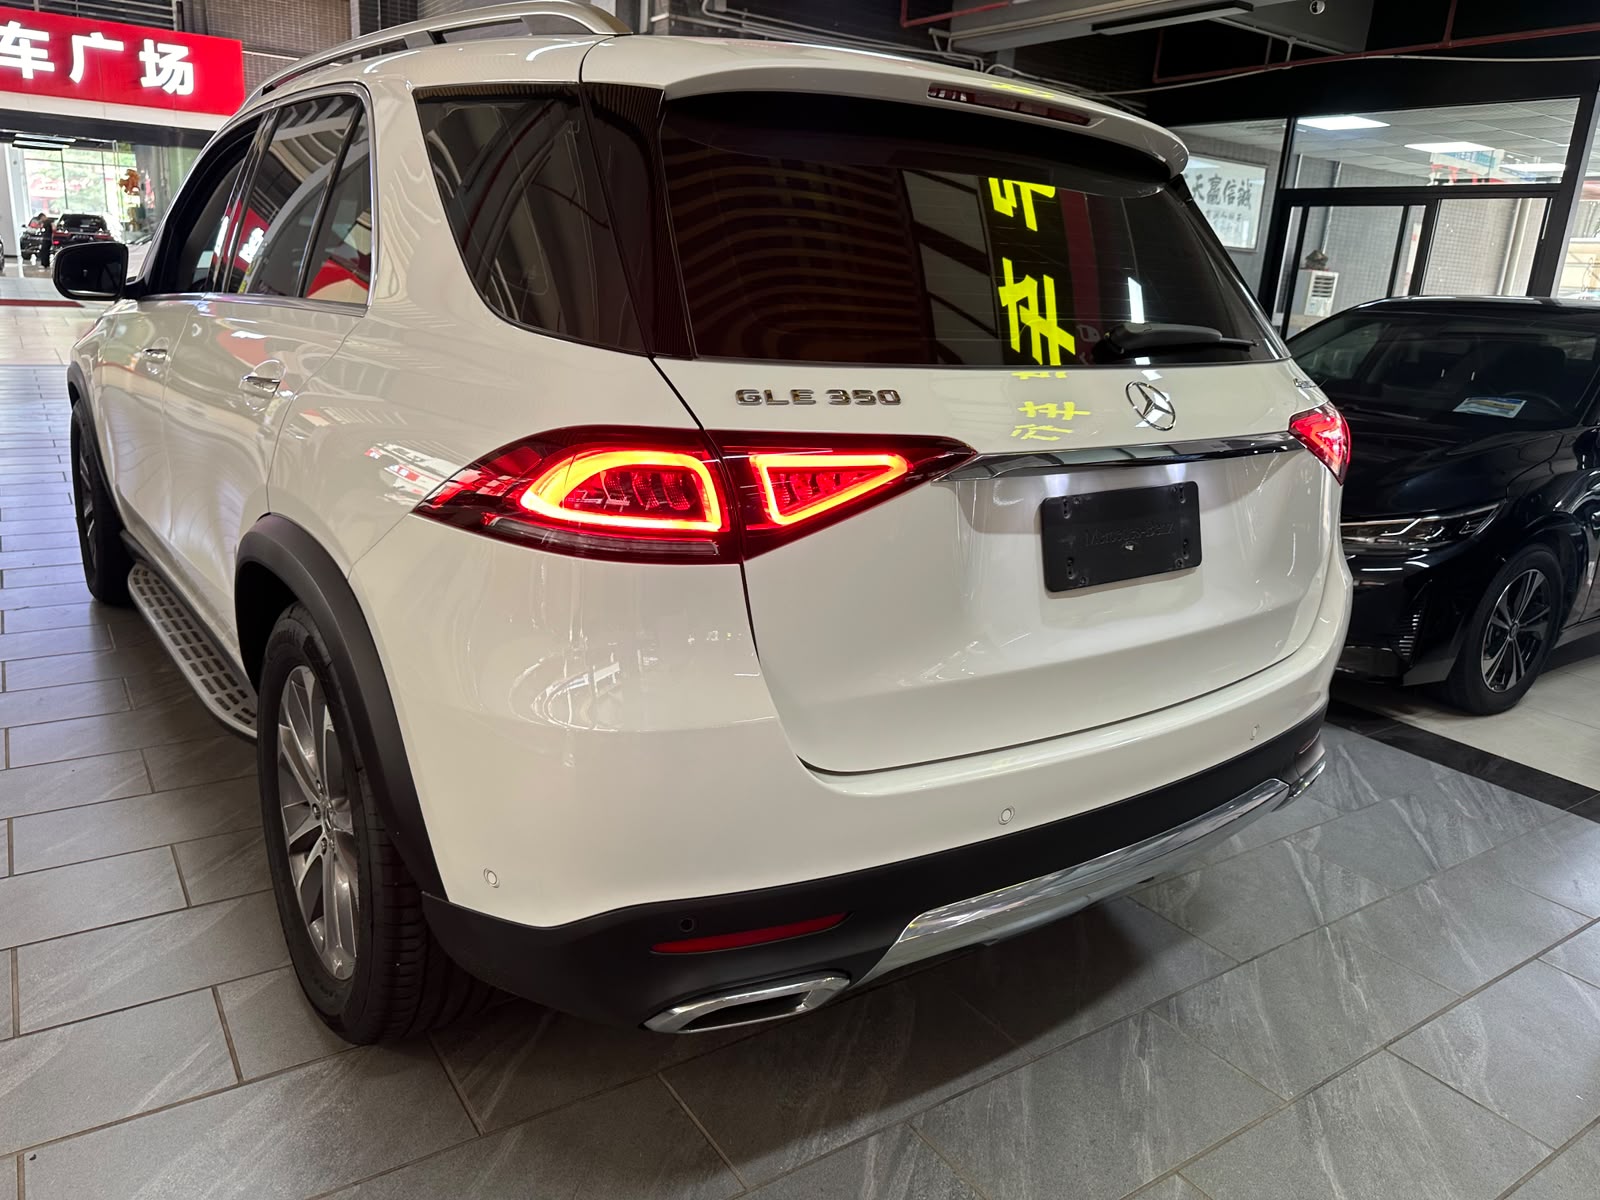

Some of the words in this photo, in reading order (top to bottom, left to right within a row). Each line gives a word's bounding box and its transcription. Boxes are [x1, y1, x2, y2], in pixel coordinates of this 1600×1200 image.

[0, 20, 195, 96] 车广场
[735, 389, 817, 406] GLE
[825, 389, 902, 406] 350
